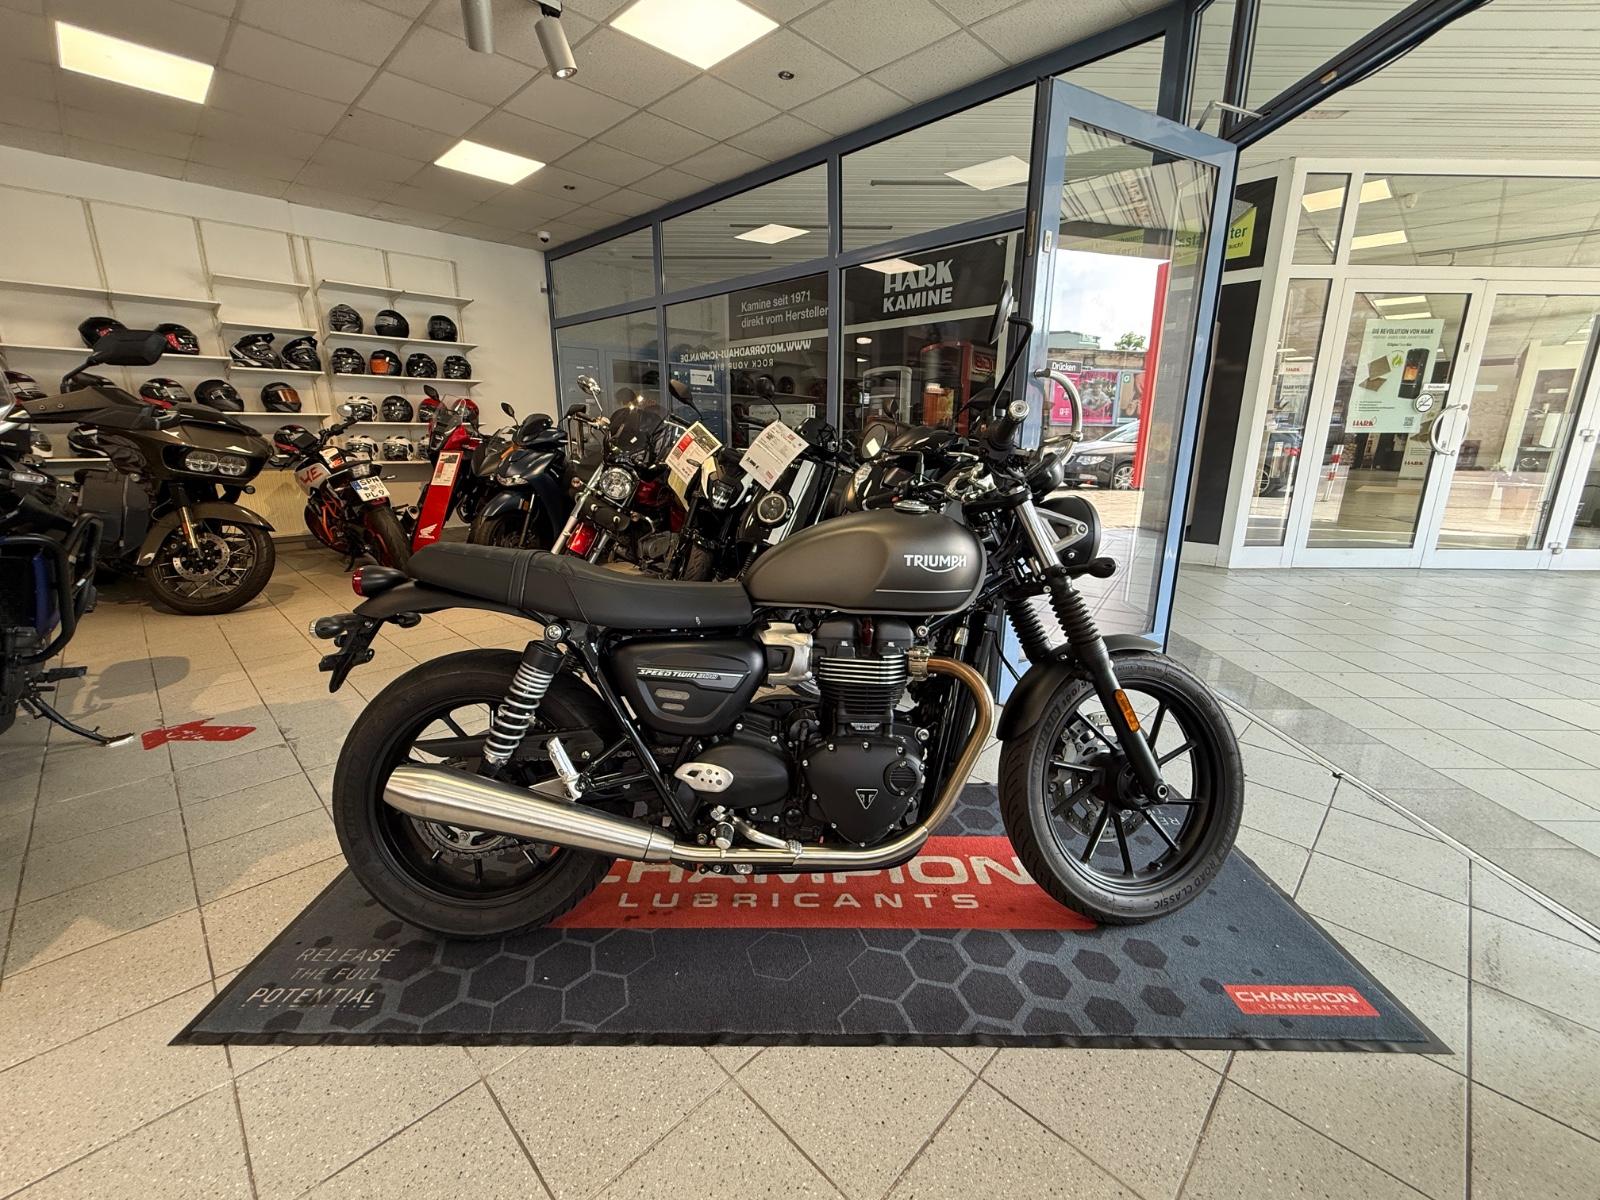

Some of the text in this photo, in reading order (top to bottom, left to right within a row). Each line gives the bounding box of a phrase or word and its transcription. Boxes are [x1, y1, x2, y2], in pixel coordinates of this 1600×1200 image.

[884, 259, 953, 294] HARK
[741, 290, 811, 313] Kamine seit 1971
[883, 287, 953, 313] KAMINE
[741, 306, 829, 328] direkt vom Hersteller
[1052, 361, 1076, 371] Drücken
[903, 554, 967, 573] TRIUMPH
[638, 669, 671, 677] SPEED
[671, 671, 698, 679] TWIN
[602, 856, 1036, 885] HION
[618, 892, 979, 909] LUBRICANTS
[1153, 884, 1193, 910] CLASSIC
[296, 948, 400, 962] RELEASE
[290, 967, 381, 980] THE FULL
[240, 987, 376, 1007] POTENTIAL
[1235, 991, 1359, 1003] CHAMPION
